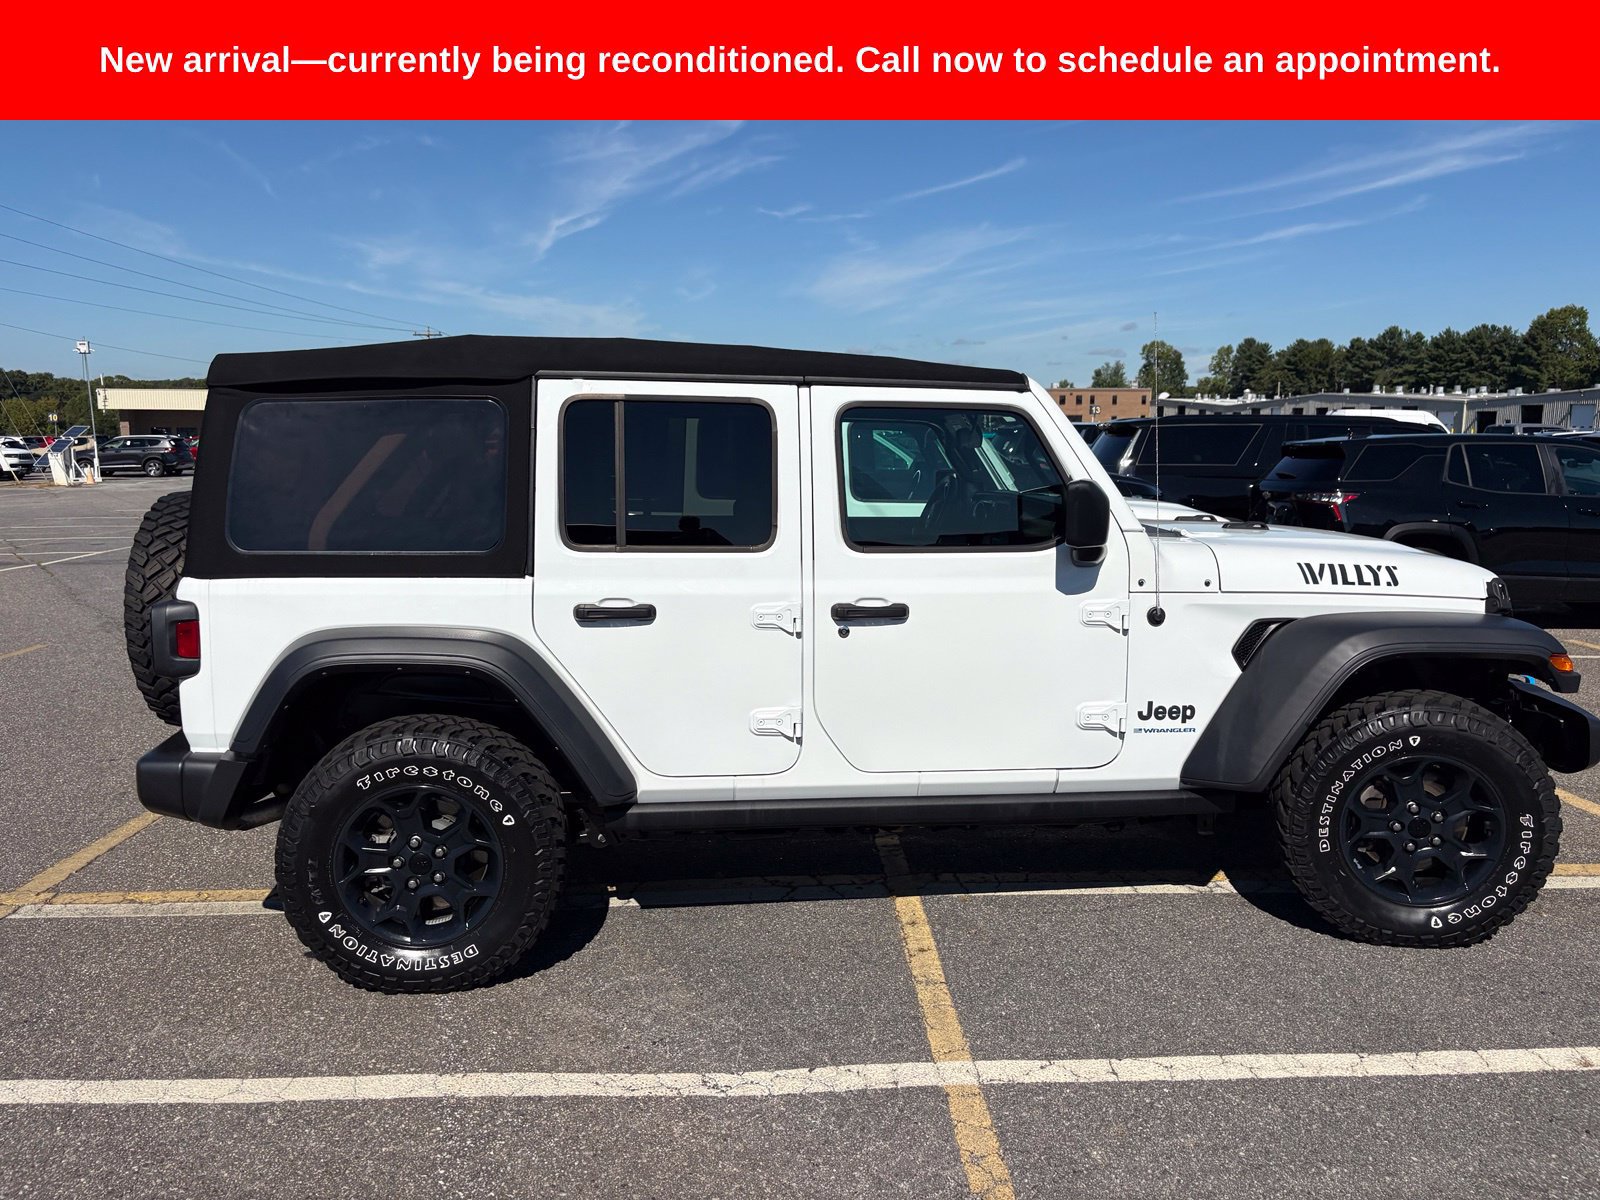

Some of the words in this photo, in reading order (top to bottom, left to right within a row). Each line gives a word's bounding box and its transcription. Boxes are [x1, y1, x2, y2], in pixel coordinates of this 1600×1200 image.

[48, 413, 58, 422] 10
[1092, 406, 1101, 414] 13
[1297, 562, 1399, 586] WILLYS
[1137, 700, 1196, 723] Jeep
[356, 765, 503, 813] Firestone
[1319, 739, 1403, 852] DESTINATION
[1448, 814, 1534, 924] Firestone
[329, 924, 479, 970] DESTINATION
